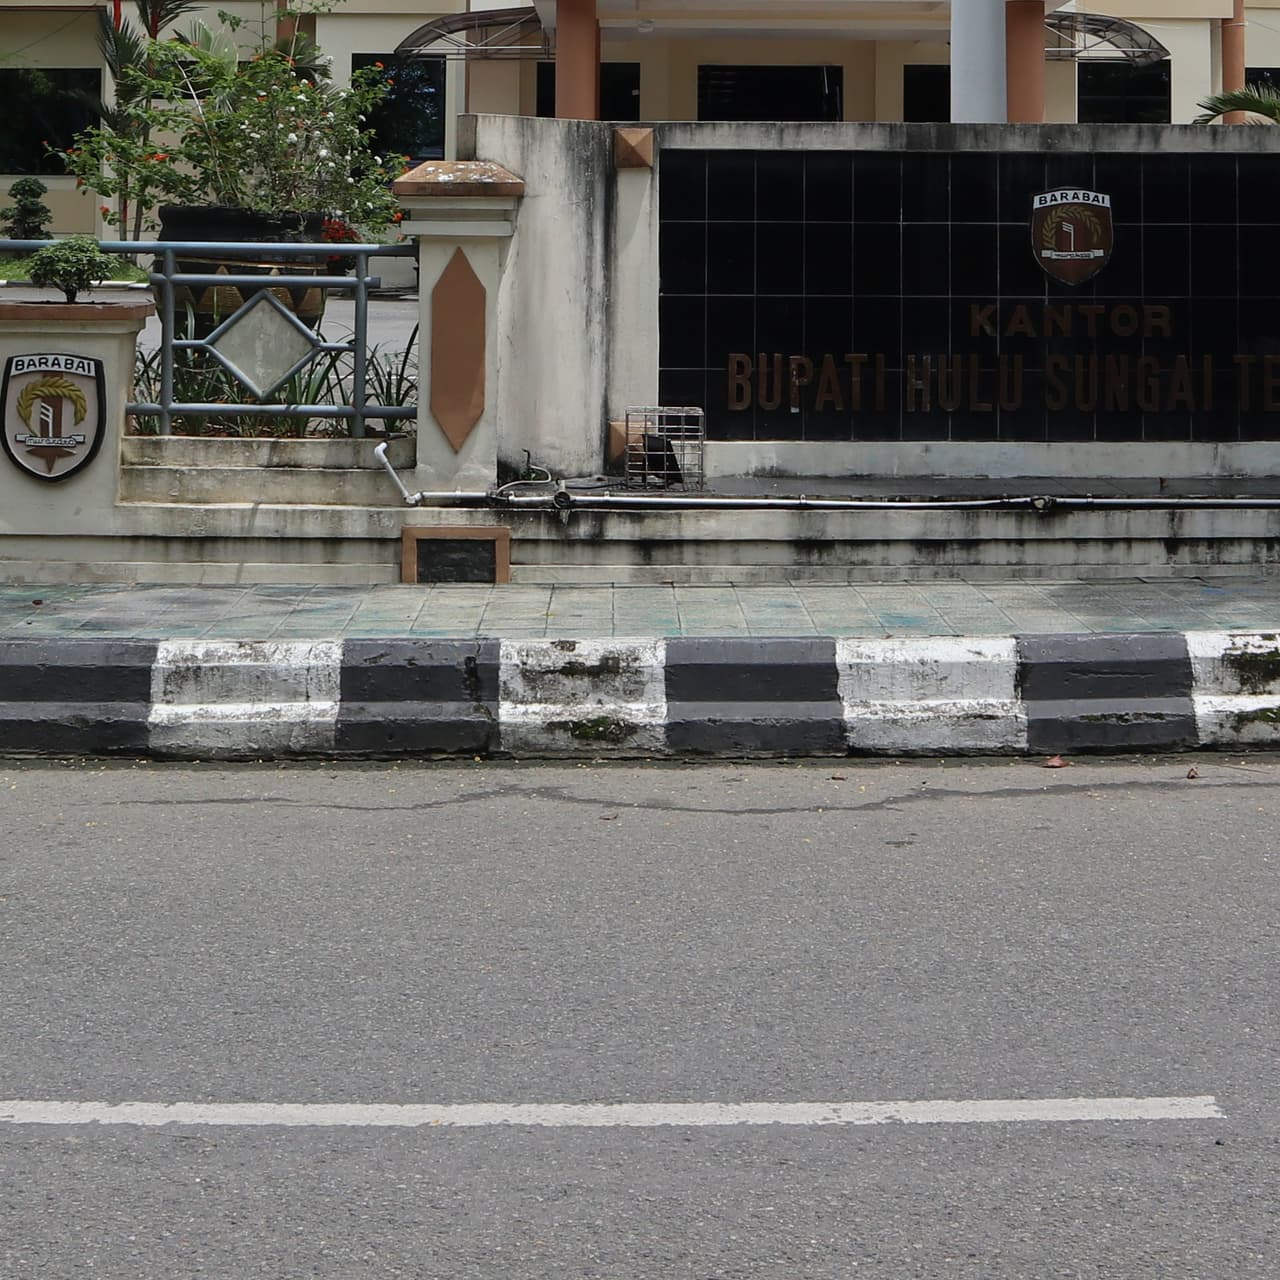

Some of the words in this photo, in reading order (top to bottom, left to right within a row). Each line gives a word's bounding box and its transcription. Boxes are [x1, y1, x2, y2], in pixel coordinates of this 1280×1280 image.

[1039, 191, 1105, 205] BARABAI
[969, 304, 1172, 337] KANTOR
[15, 357, 92, 374] BARABAI
[727, 353, 886, 413] BUPATI
[906, 353, 1024, 412] HULU
[1045, 352, 1213, 412] SUNGAI
